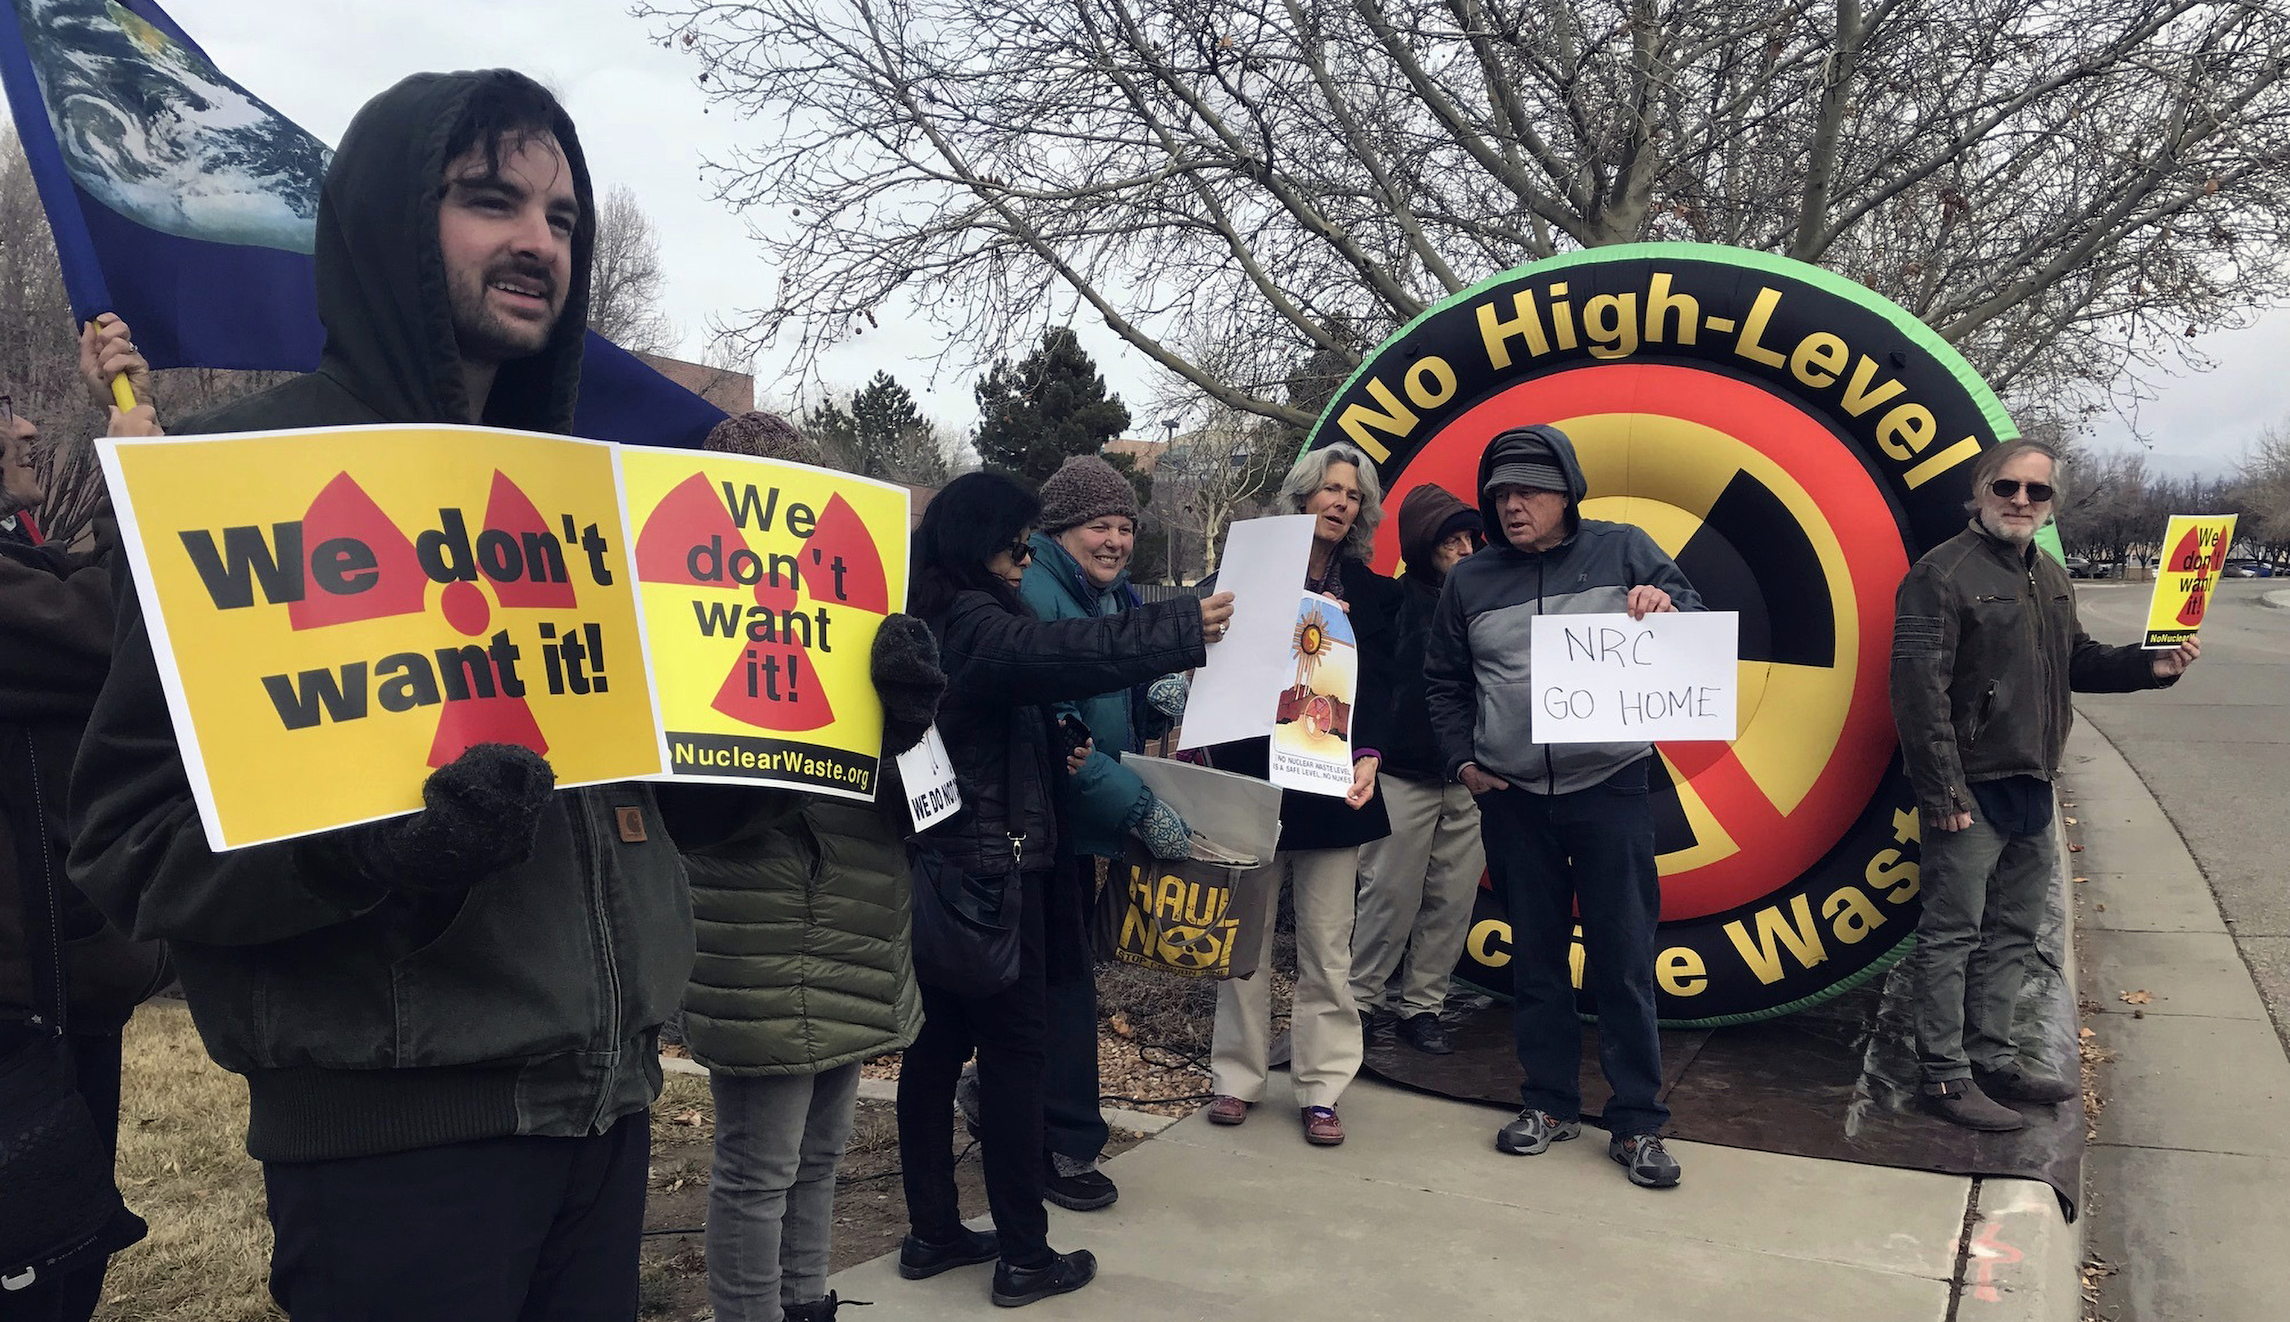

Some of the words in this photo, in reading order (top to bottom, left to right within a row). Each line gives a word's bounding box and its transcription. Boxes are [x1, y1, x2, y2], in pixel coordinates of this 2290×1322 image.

[1336, 354, 1459, 465] No
[1476, 273, 1985, 490] High-Level
[721, 481, 816, 539] We
[177, 520, 380, 611] We
[416, 508, 613, 586] don't
[2183, 551, 2220, 570] don't
[2199, 528, 2219, 547] We
[686, 535, 848, 602] don't
[2180, 574, 2212, 593] want
[691, 600, 832, 653] want
[2186, 595, 2203, 615] it!
[1564, 626, 1654, 668] NRC
[261, 629, 525, 731] want
[539, 623, 608, 696] it!
[746, 650, 799, 703] it!
[1543, 686, 1595, 720] GO
[1618, 686, 1722, 726] HOME
[669, 742, 870, 791] NuclearWaste.org
[1277, 754, 1287, 763] NO
[1288, 756, 1315, 768] NUCLEAR
[911, 794, 932, 821] WE
[929, 787, 944, 813] DO
[1129, 865, 1239, 927] HAUL
[1722, 806, 1921, 987] Wast
[1117, 950, 1147, 963] STOP
